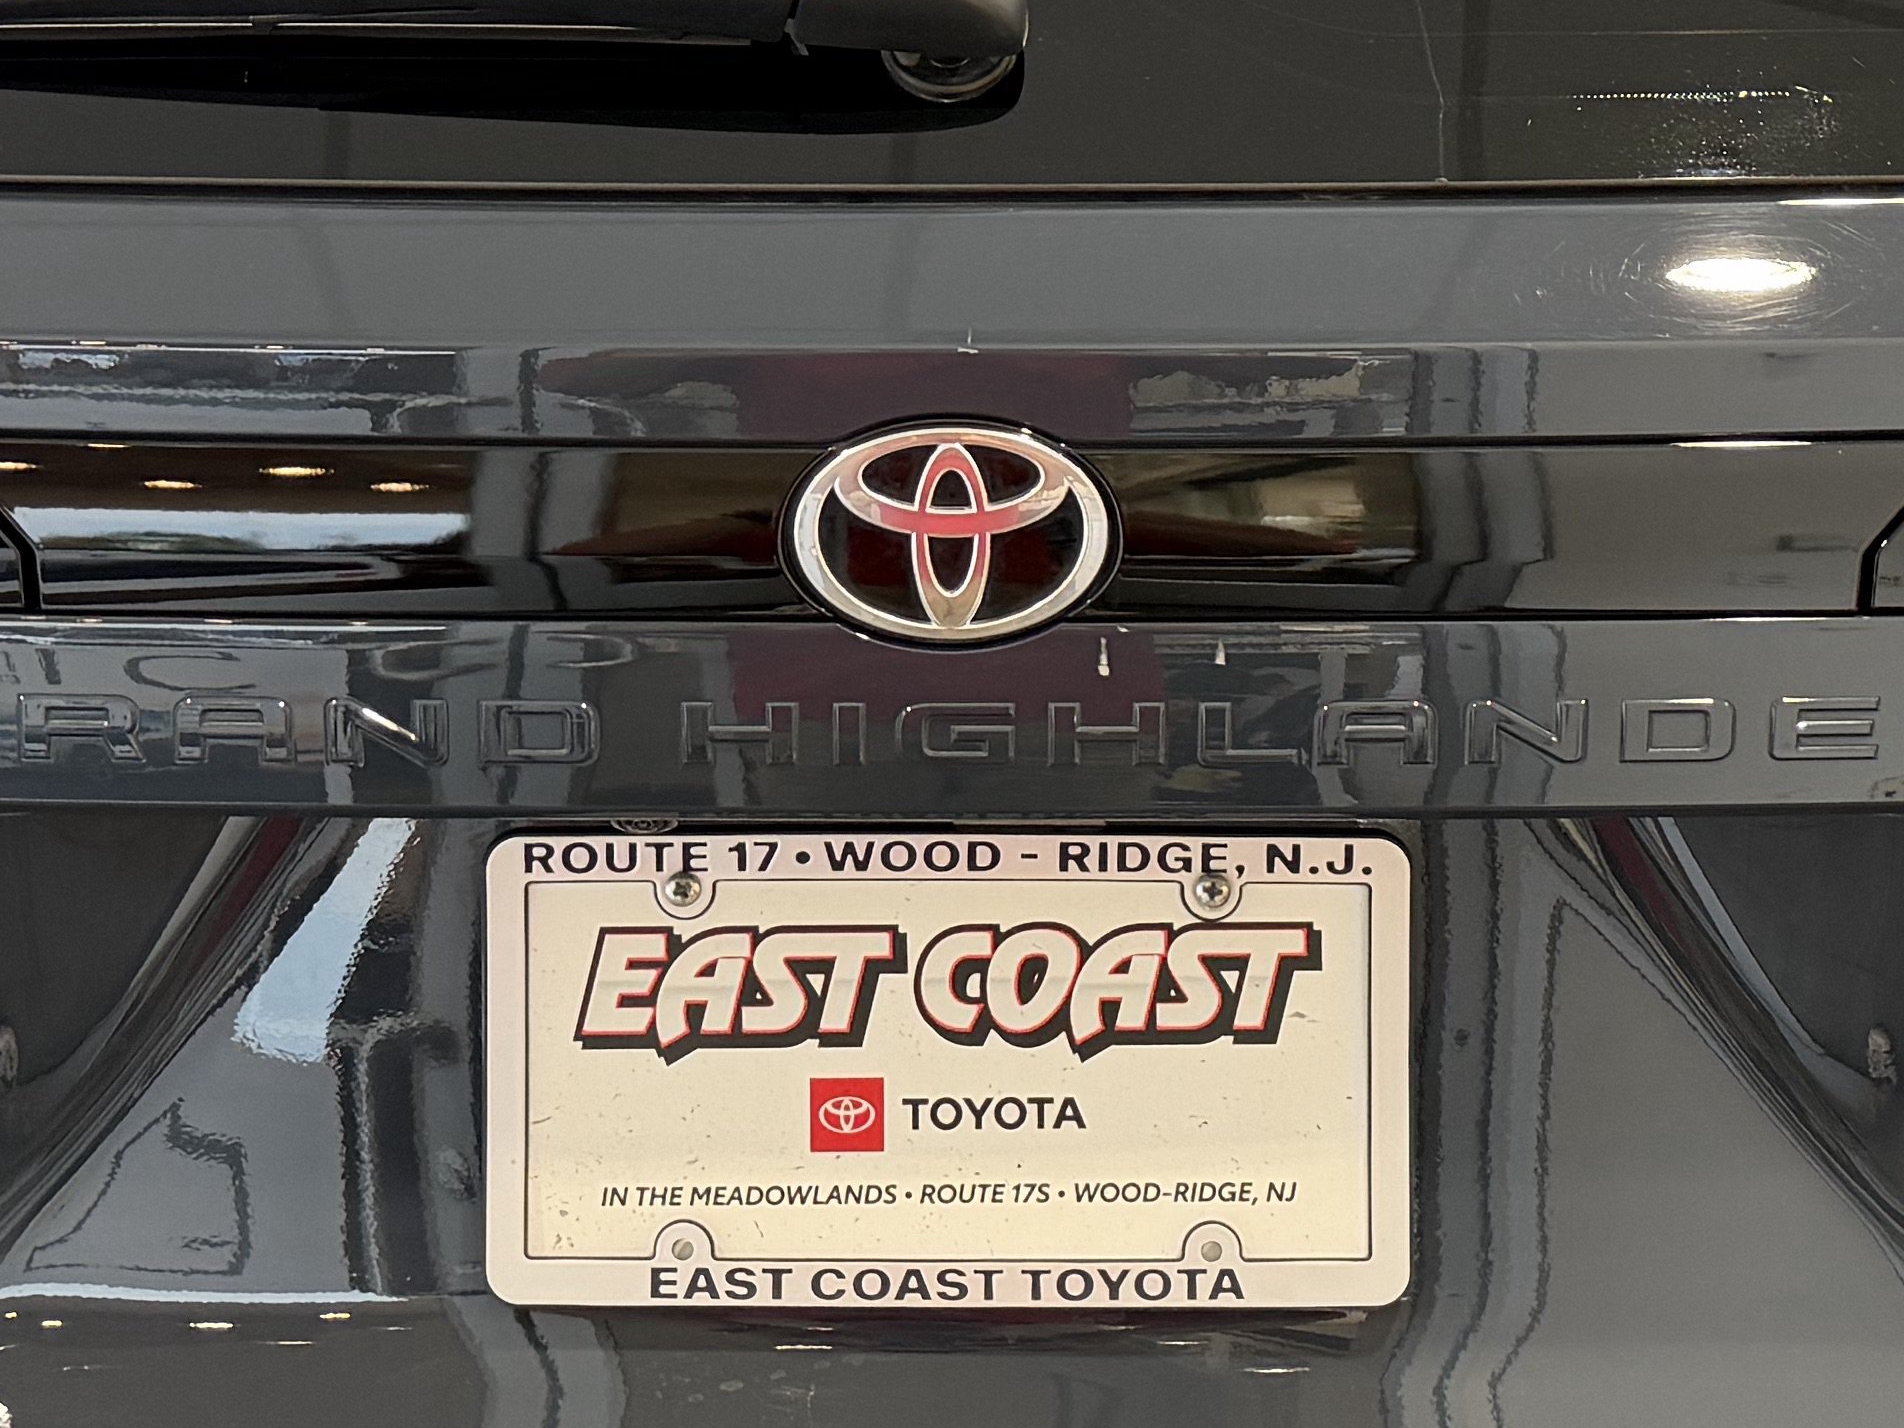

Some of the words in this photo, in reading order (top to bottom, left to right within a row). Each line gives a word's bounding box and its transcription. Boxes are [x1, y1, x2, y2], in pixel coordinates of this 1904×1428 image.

[524, 841, 709, 873] ROUTE
[728, 841, 781, 872] 17
[824, 841, 1001, 873] WOOD
[1059, 841, 1245, 878] RIDGE,
[1266, 843, 1373, 875] N.J.
[573, 924, 908, 1066] EAST
[913, 921, 1322, 1063] COAST
[902, 1096, 1087, 1131] TOYOTA
[601, 1185, 629, 1207] IN
[635, 1185, 684, 1207] THE
[689, 1183, 897, 1207] MEADOWLANDS
[920, 1183, 1005, 1205] ROUTE
[1011, 1182, 1051, 1205] 17S
[1074, 1181, 1259, 1207] WOOD-RIDGE,
[1266, 1180, 1298, 1204] NJ
[650, 1267, 793, 1301] EAST
[811, 1267, 1004, 1302] COAST
[1021, 1267, 1245, 1302] TOYOTA
